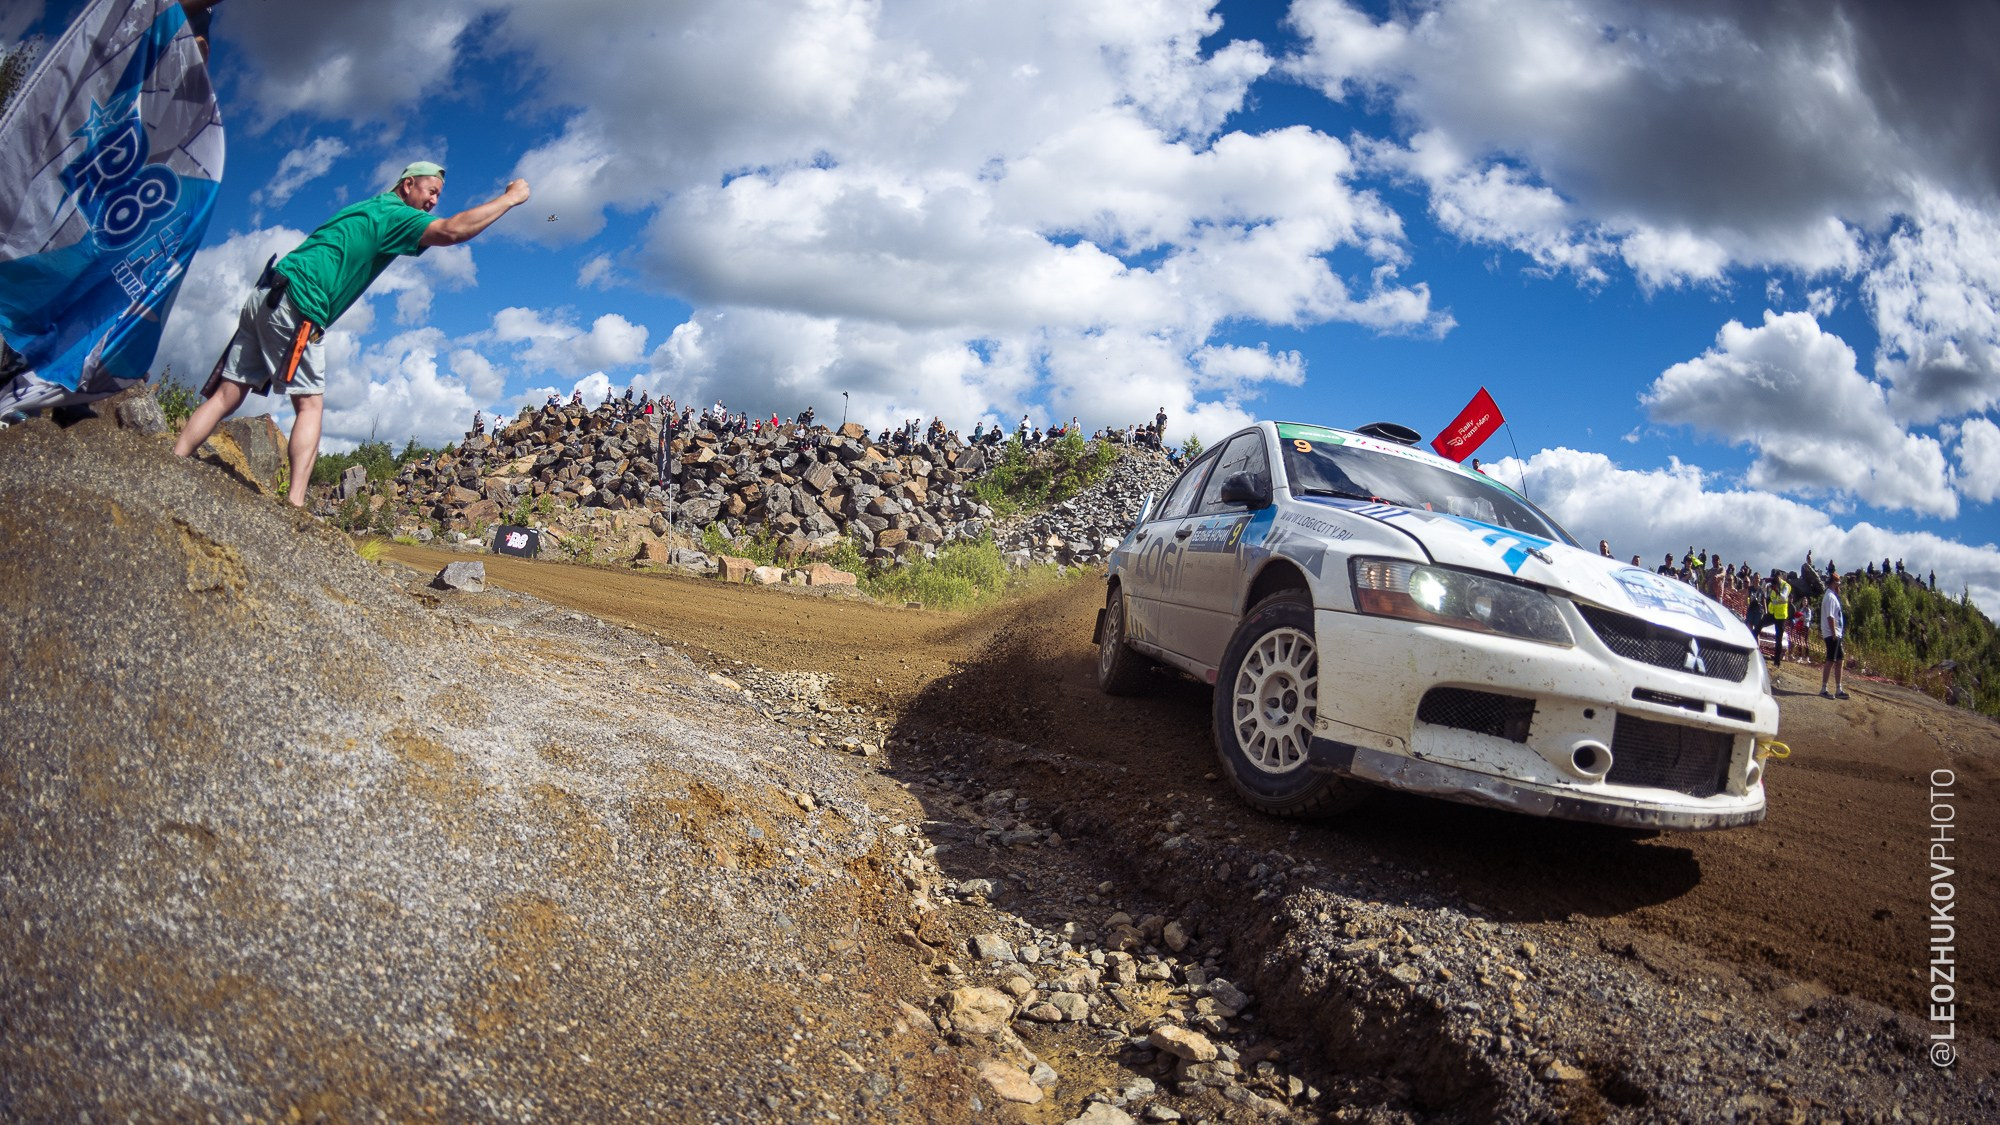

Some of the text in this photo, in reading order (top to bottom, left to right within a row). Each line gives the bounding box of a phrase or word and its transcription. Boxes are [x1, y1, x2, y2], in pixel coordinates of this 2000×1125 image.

[1458, 420, 1474, 435] Rally
[1463, 414, 1490, 441] Fans Map
[1293, 439, 1313, 453] 9
[1228, 523, 1243, 546] 9
[1280, 510, 1354, 541] WWW.LOGICCITY.RU
